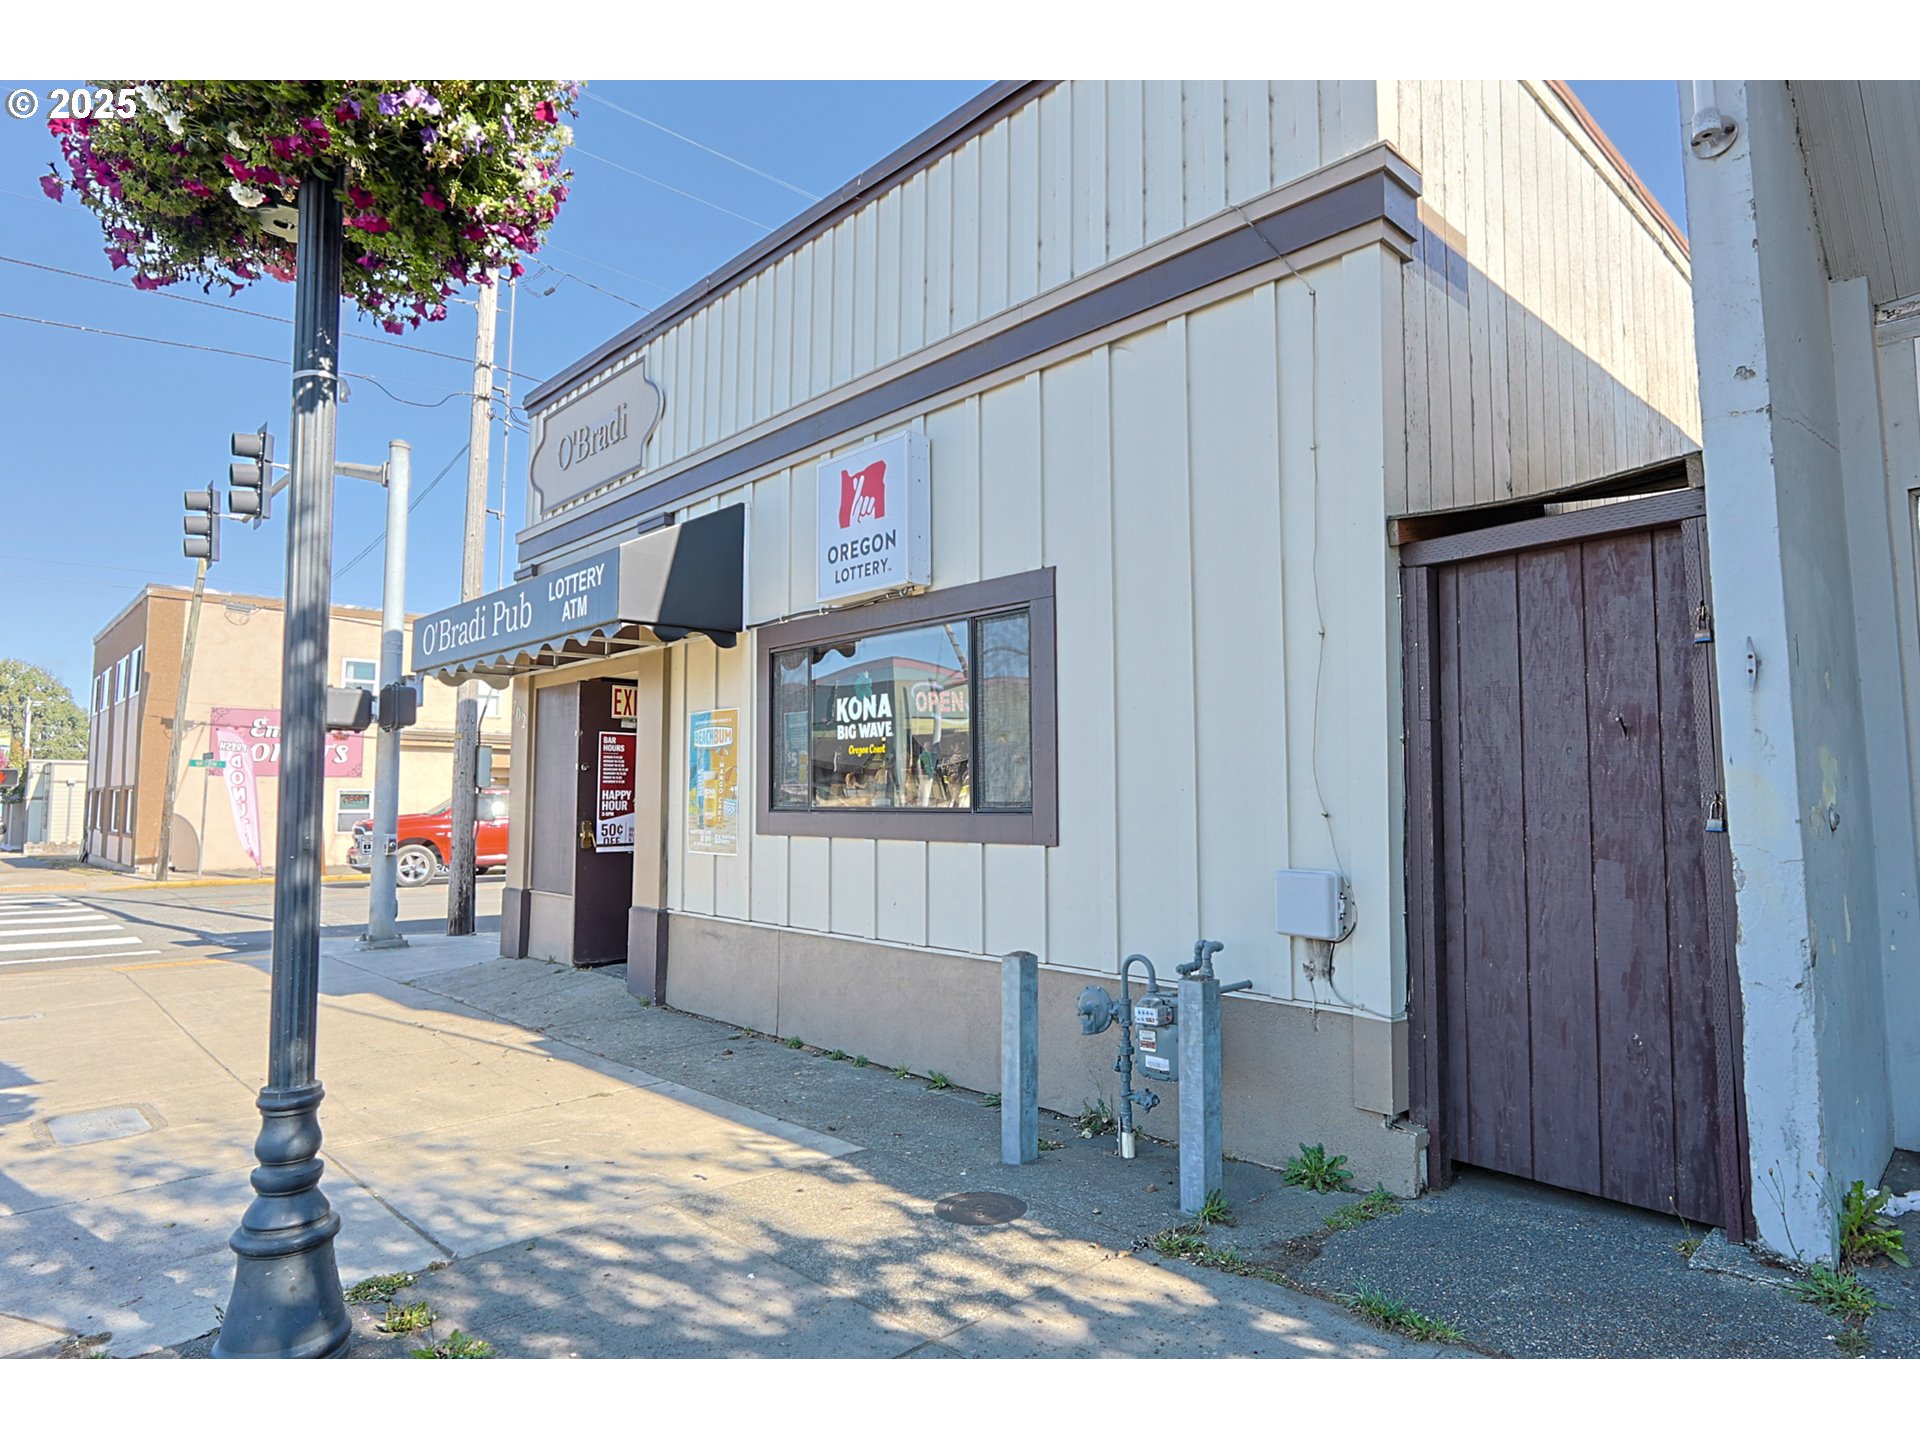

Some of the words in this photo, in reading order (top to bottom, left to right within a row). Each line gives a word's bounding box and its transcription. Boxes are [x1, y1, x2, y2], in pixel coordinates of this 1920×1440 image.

[558, 402, 628, 471] O'Bradi
[827, 529, 896, 564] OREGON
[548, 563, 605, 602] LOTTERY
[835, 557, 888, 584] LOTTERY
[561, 595, 588, 622] ATM
[422, 604, 487, 656] O'Bradi
[492, 591, 533, 637] Pub
[614, 688, 637, 716] EXI
[836, 693, 892, 723] KONA
[915, 691, 965, 712] OPEN
[603, 736, 616, 744] BAR
[837, 724, 857, 740] BIG
[858, 721, 893, 738] WAVE
[601, 790, 632, 800] HAPPY
[601, 801, 628, 811] HOUR
[601, 824, 623, 837] 50¢
